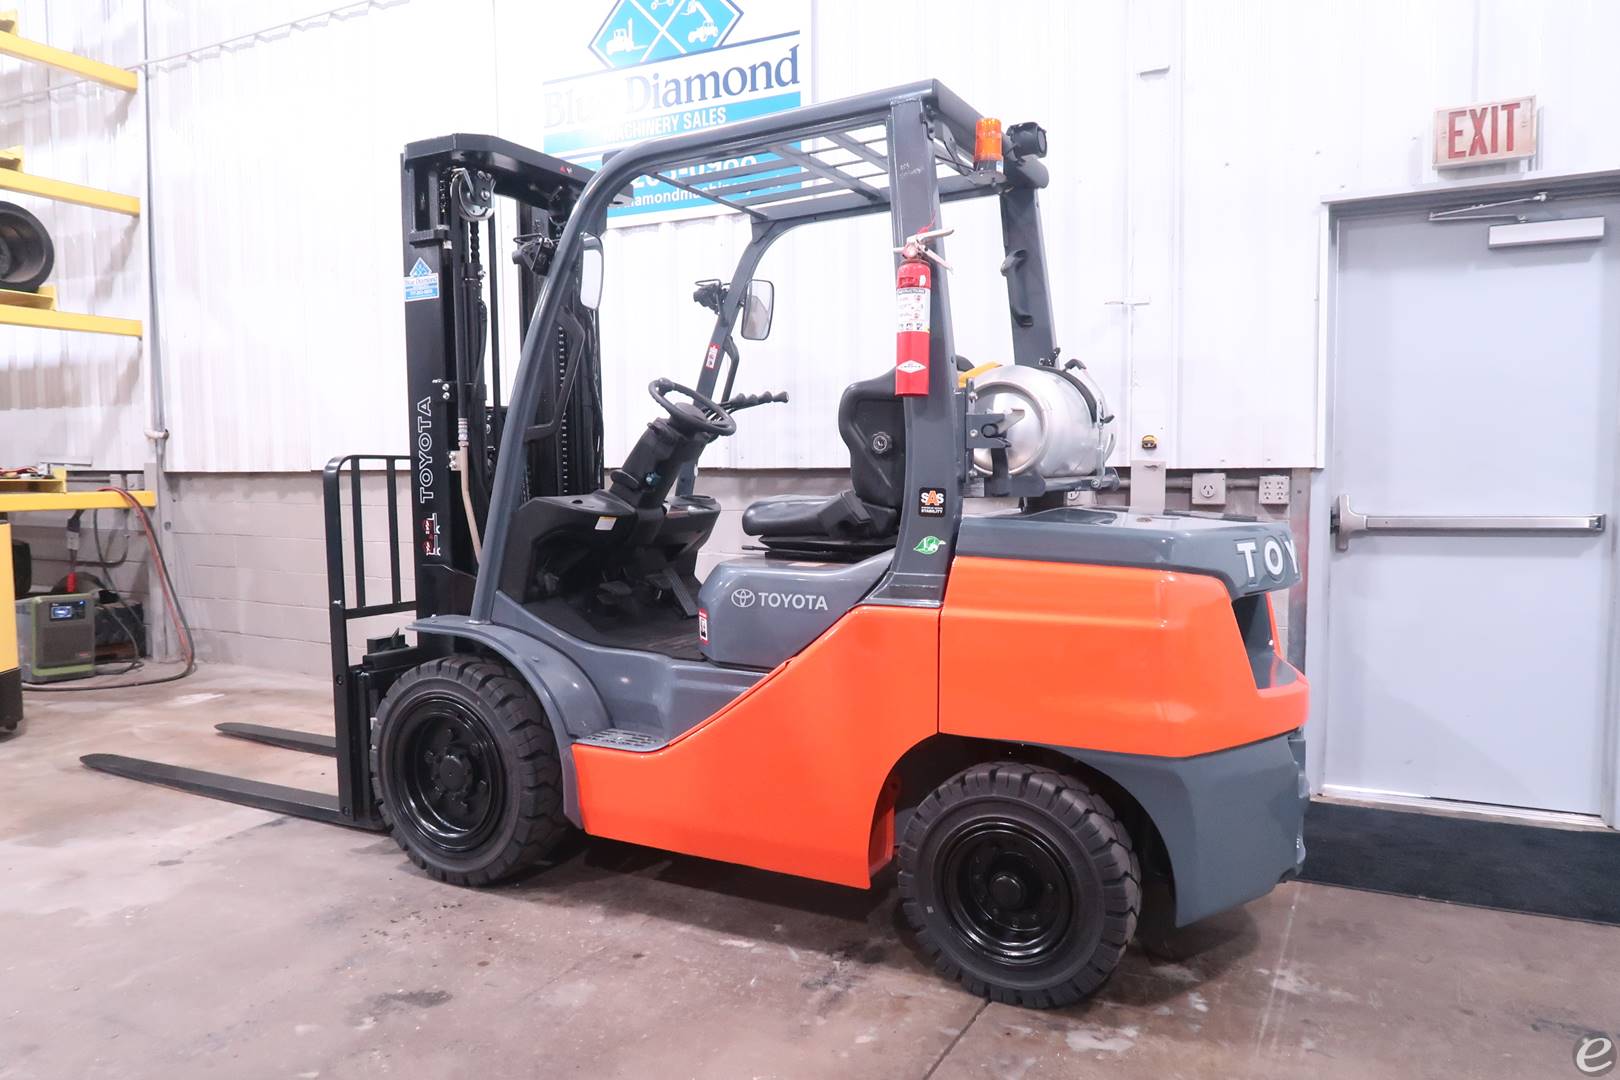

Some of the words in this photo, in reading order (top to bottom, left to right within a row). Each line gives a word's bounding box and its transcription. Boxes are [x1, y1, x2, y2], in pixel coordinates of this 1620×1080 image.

[626, 44, 799, 111] Diamond
[600, 118, 679, 144] MACHINERY
[683, 107, 727, 131] SALES
[1448, 102, 1521, 159] EXIT
[417, 396, 434, 503] TOYOTA
[921, 490, 945, 506] SAS
[758, 592, 828, 611] TOYOTA
